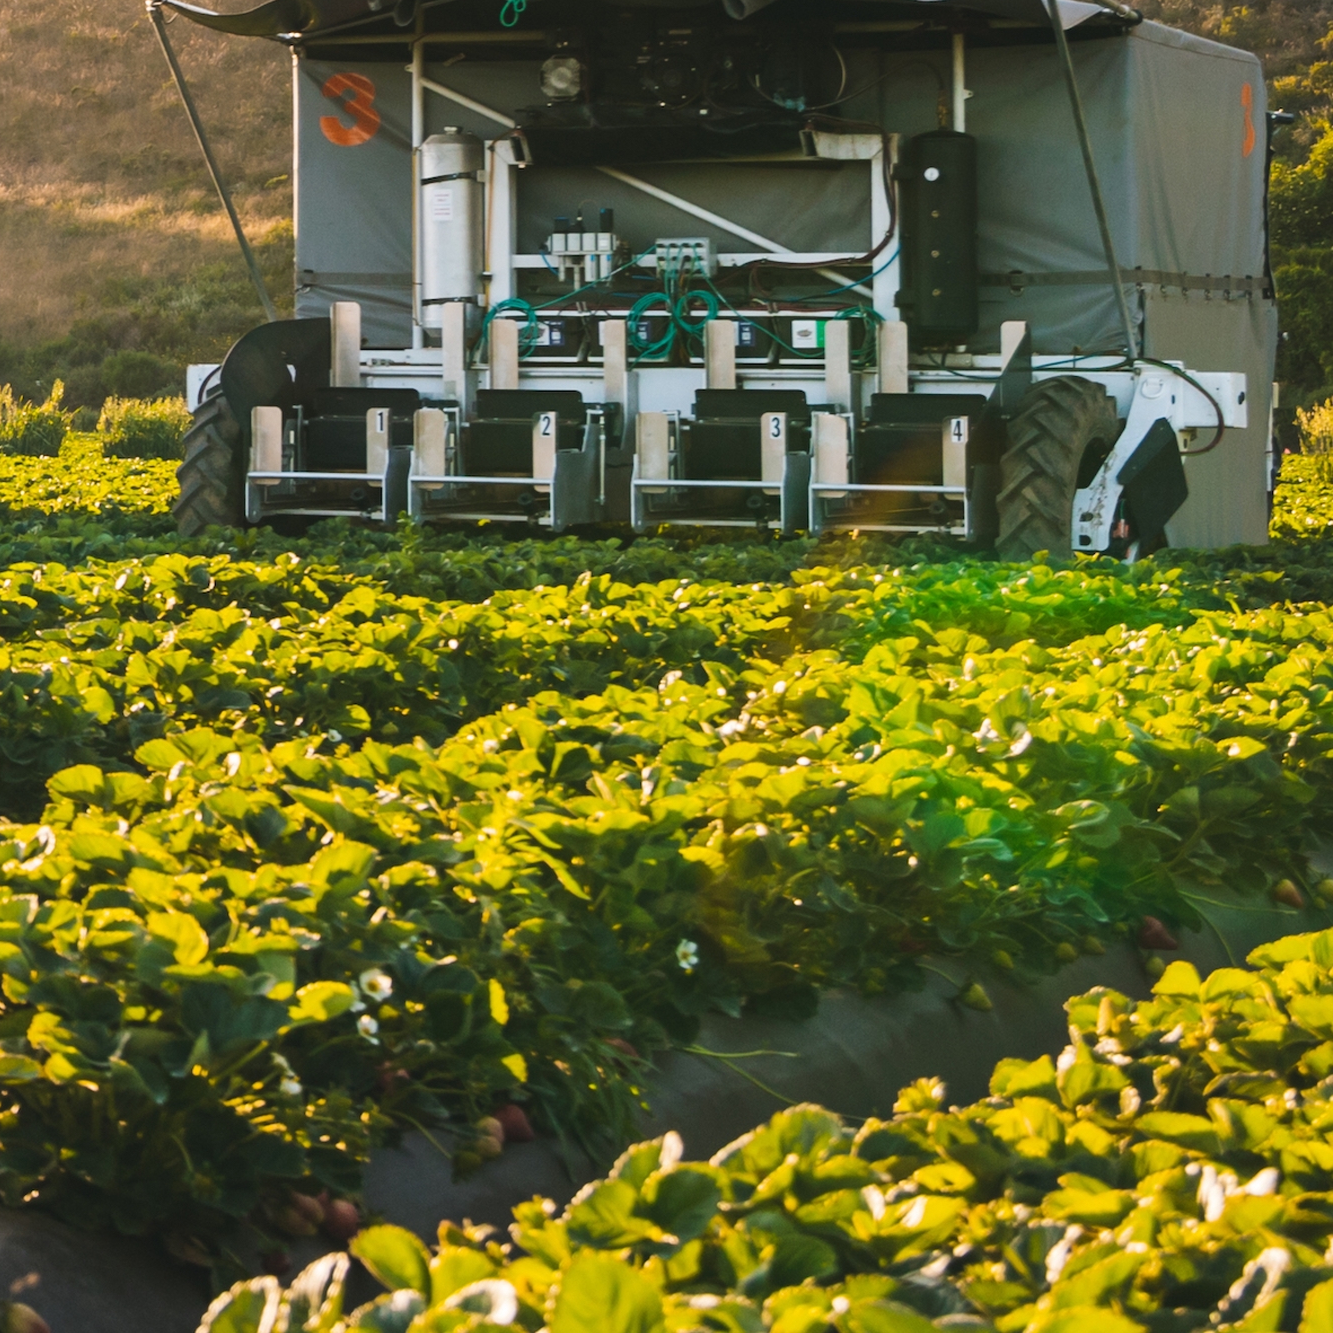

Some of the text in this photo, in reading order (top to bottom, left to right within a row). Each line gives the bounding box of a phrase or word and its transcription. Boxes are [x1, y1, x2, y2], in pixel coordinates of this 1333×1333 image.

[320, 73, 380, 146] 3
[377, 412, 384, 431] 1
[542, 415, 551, 436] 2
[771, 416, 781, 438] 3
[952, 420, 963, 442] 4
